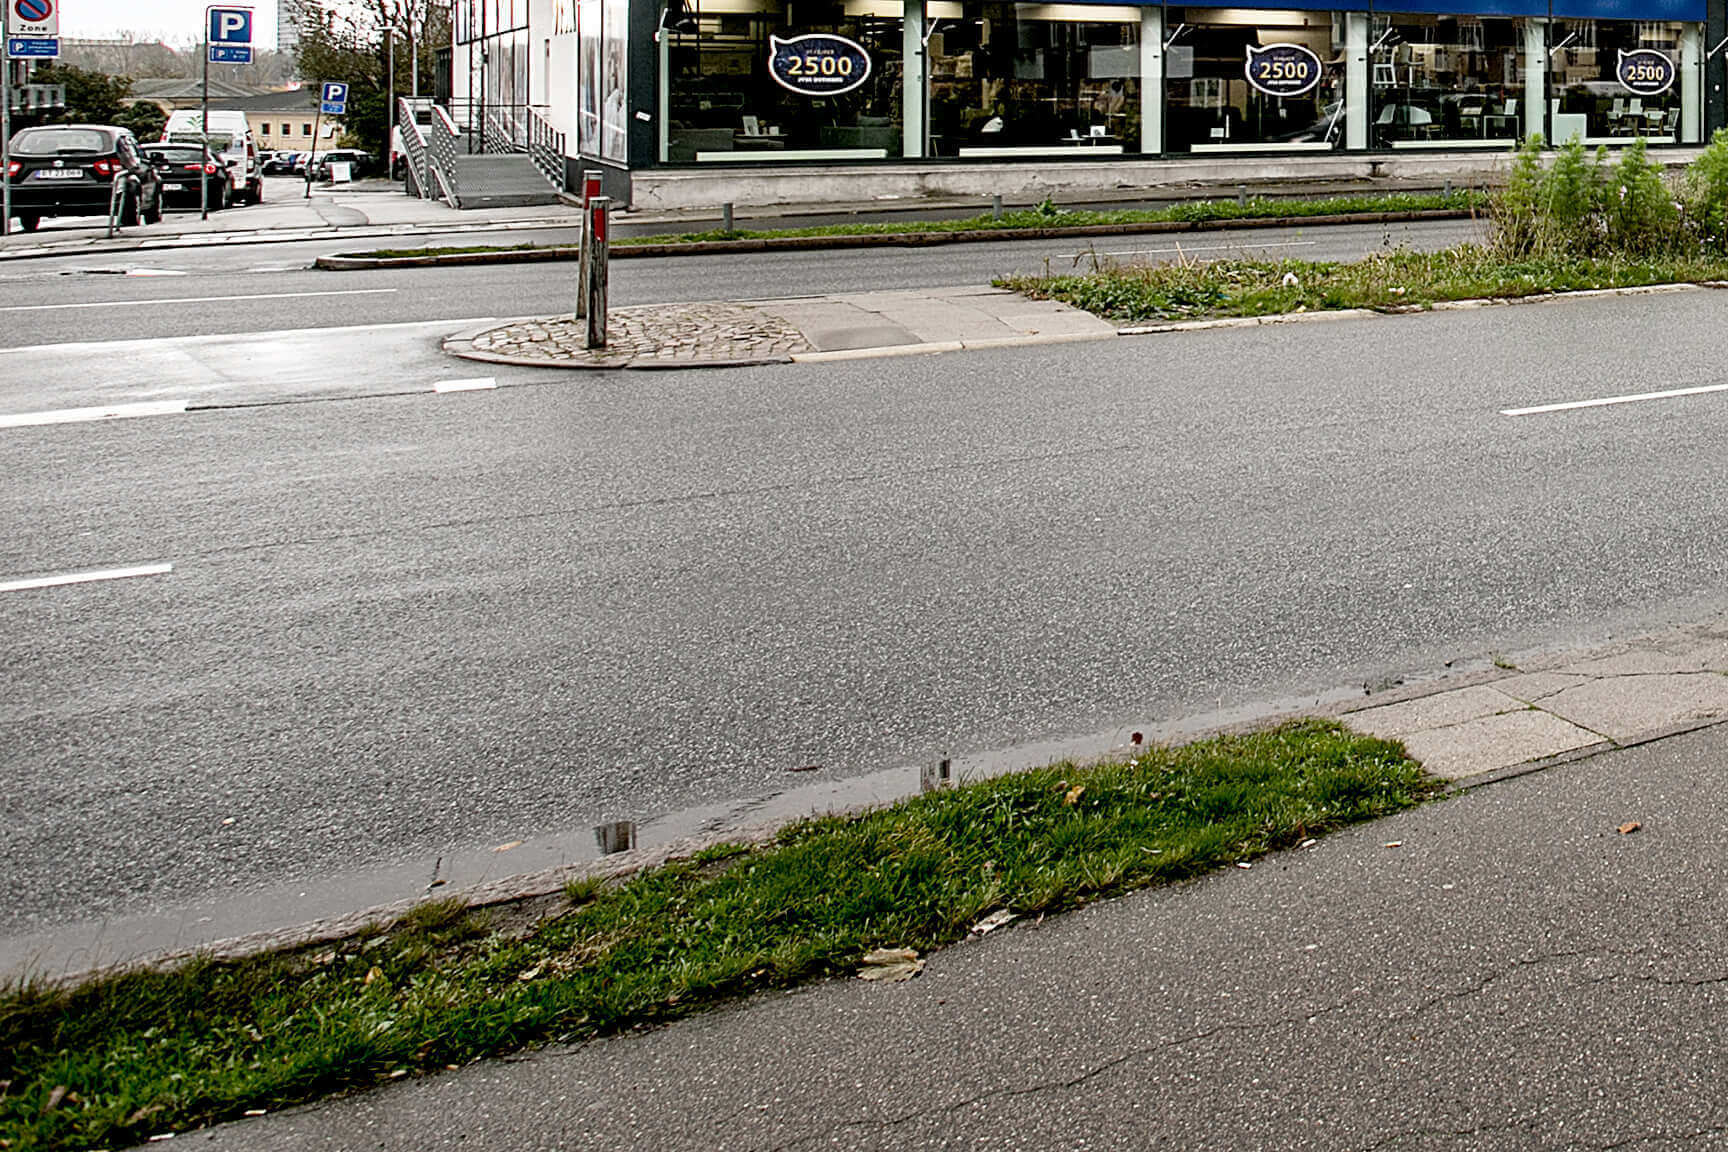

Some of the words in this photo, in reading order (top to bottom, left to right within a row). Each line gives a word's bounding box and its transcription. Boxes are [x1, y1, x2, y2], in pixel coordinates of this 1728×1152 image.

[20, 24, 48, 32] Zone
[220, 13, 245, 40] P
[787, 56, 852, 76] 2500
[1259, 61, 1308, 79] 2500
[1627, 64, 1665, 81] 2500
[328, 85, 344, 101] P
